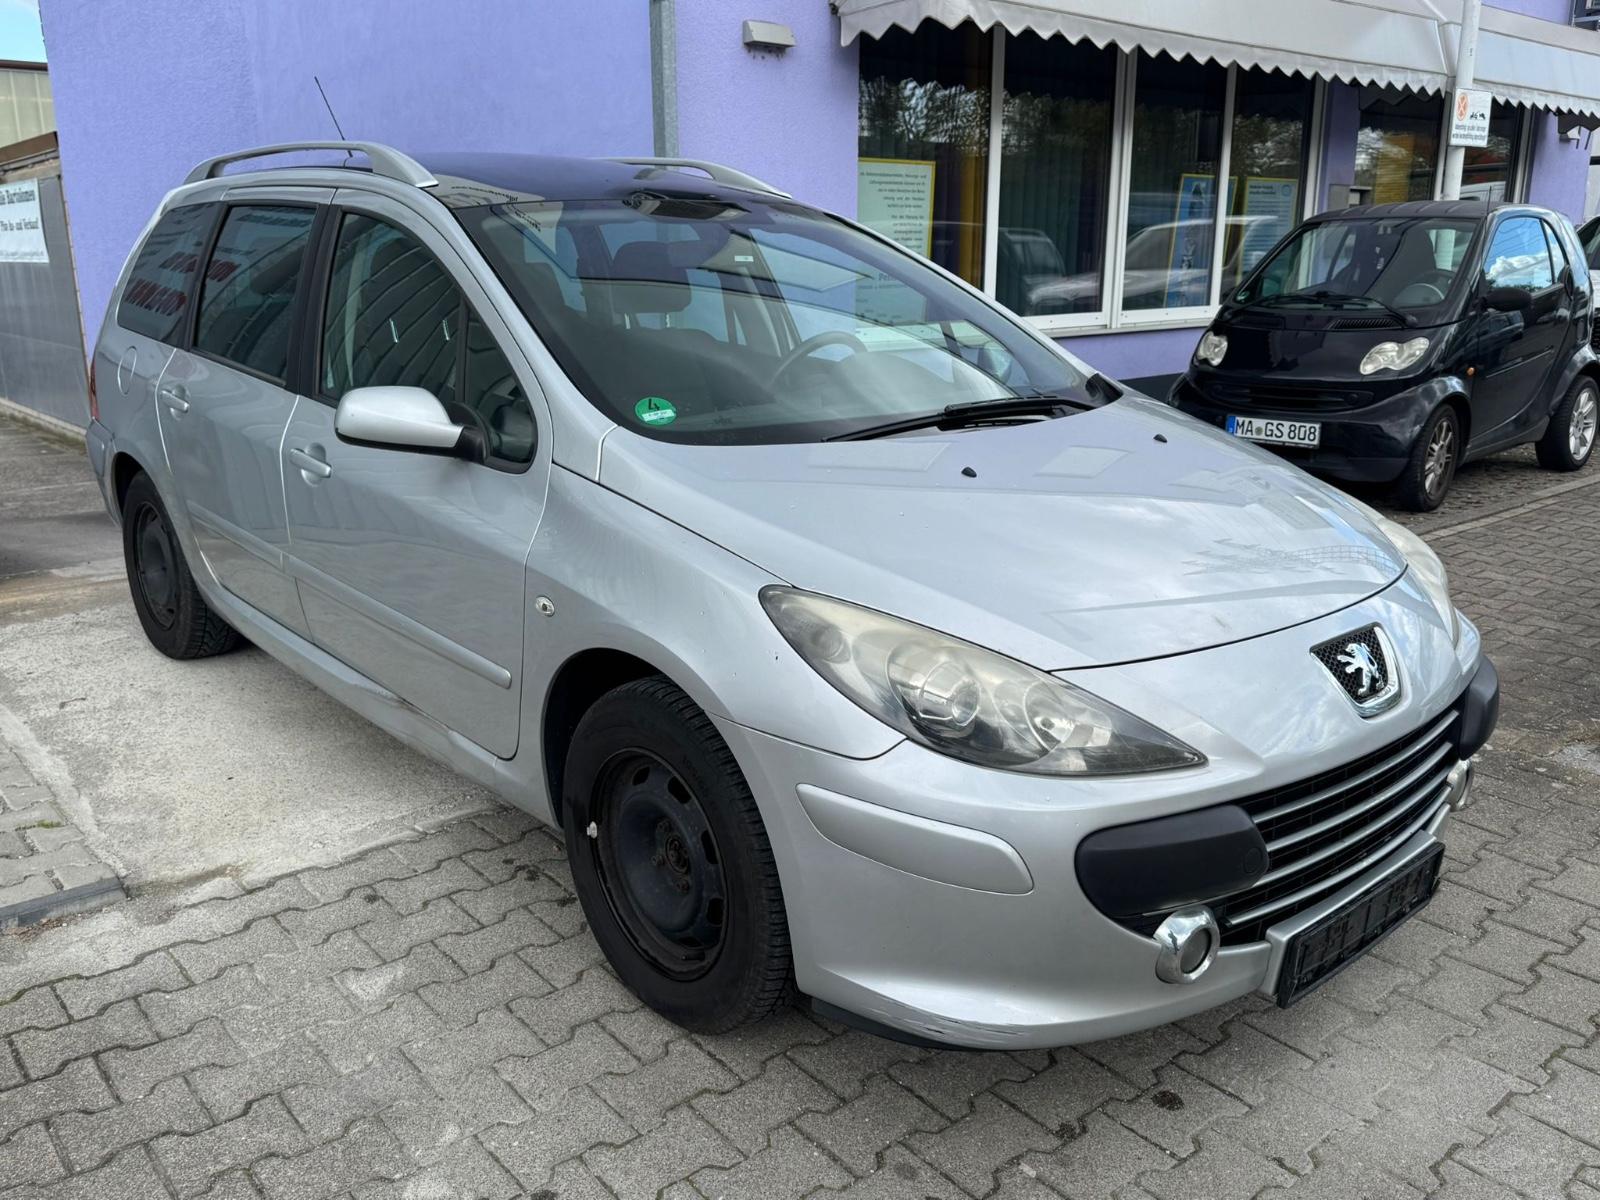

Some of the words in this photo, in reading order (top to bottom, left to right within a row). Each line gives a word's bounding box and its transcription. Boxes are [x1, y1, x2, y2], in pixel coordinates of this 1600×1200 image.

[648, 398, 660, 411] 4
[1235, 419, 1254, 436] MA
[1264, 422, 1284, 439] GS
[1288, 424, 1317, 442] 808
